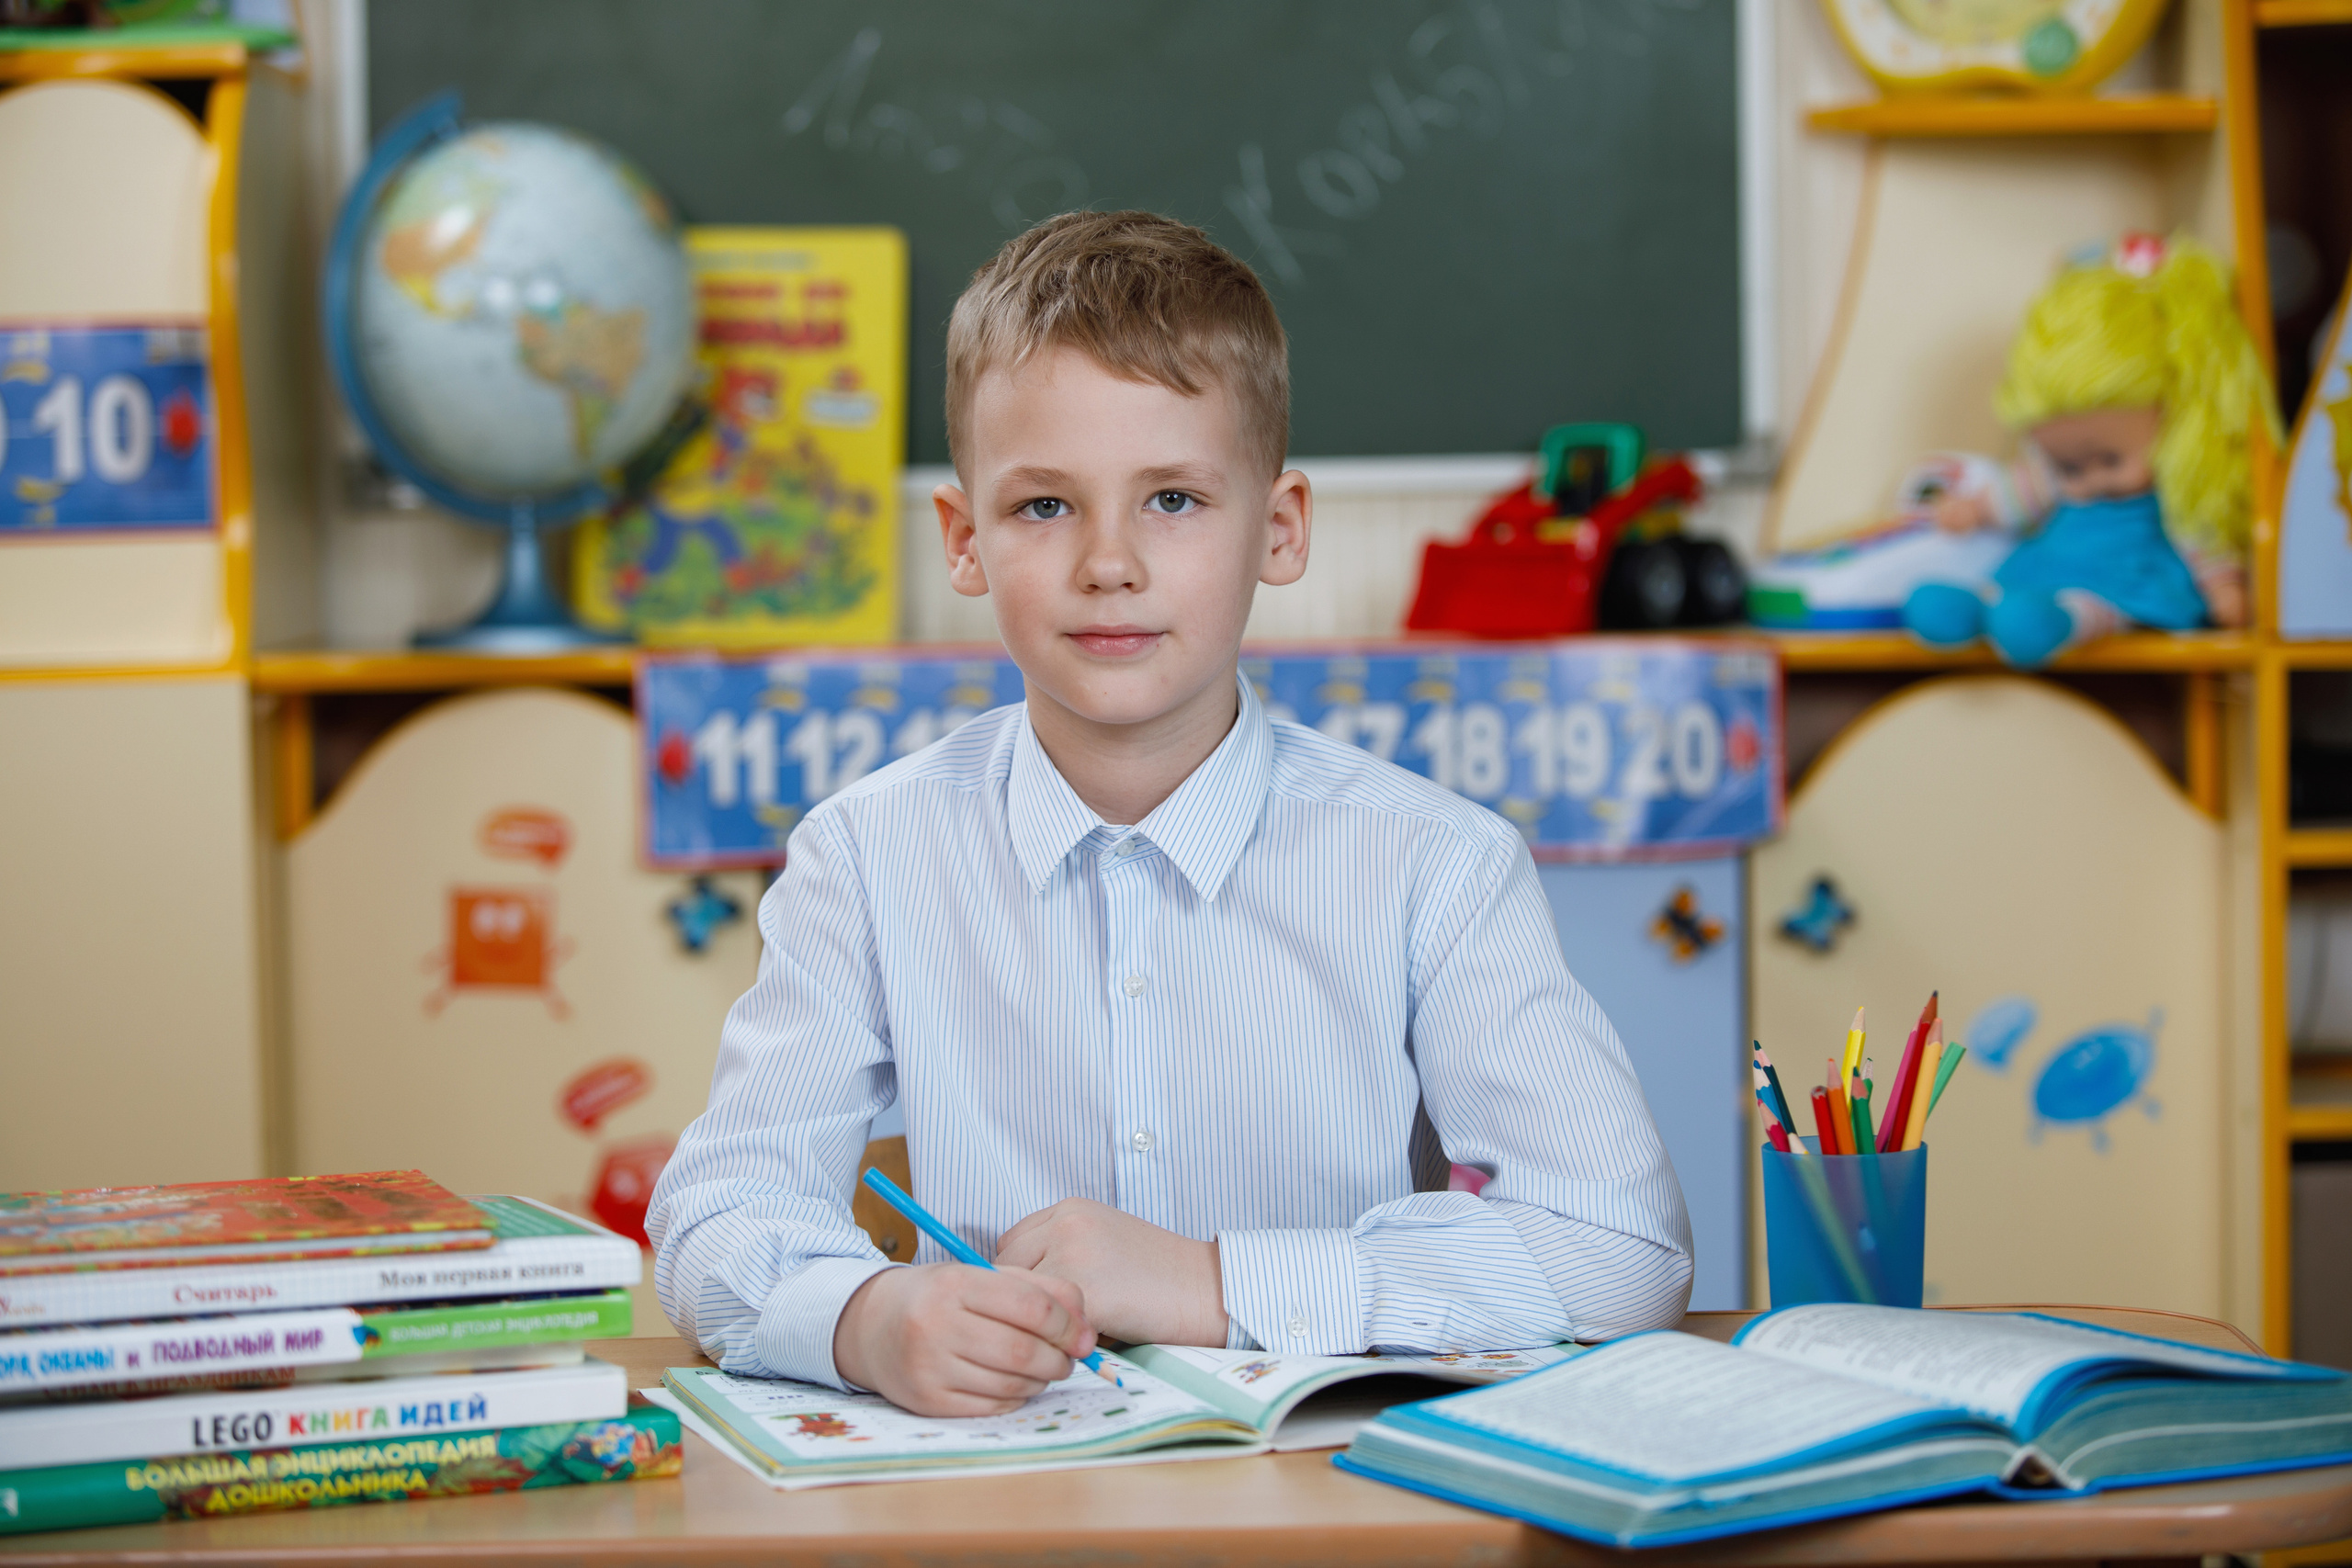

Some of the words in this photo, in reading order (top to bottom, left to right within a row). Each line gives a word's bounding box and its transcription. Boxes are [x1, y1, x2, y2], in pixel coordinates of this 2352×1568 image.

[33, 372, 155, 483] 10
[699, 709, 778, 808] 11
[787, 707, 885, 802] 12
[1415, 701, 1510, 801] 18
[1514, 701, 1610, 800] 19
[1622, 701, 1722, 800] 20
[379, 1269, 427, 1288] Моя
[434, 1264, 512, 1287] первая
[519, 1260, 584, 1280] книга
[153, 1328, 275, 1364] ПОДВОДНЫЙ
[284, 1327, 324, 1351] МИР
[192, 1411, 273, 1448] LEGO
[288, 1408, 390, 1436] КНИГА
[399, 1393, 488, 1427] ИДЕЙ
[126, 1450, 269, 1492] БОЛЬШАЯ
[275, 1434, 497, 1476] ЭНЦИКЛОПЕДИЯ
[205, 1467, 429, 1514] ДОШКОЛЬНИКА
